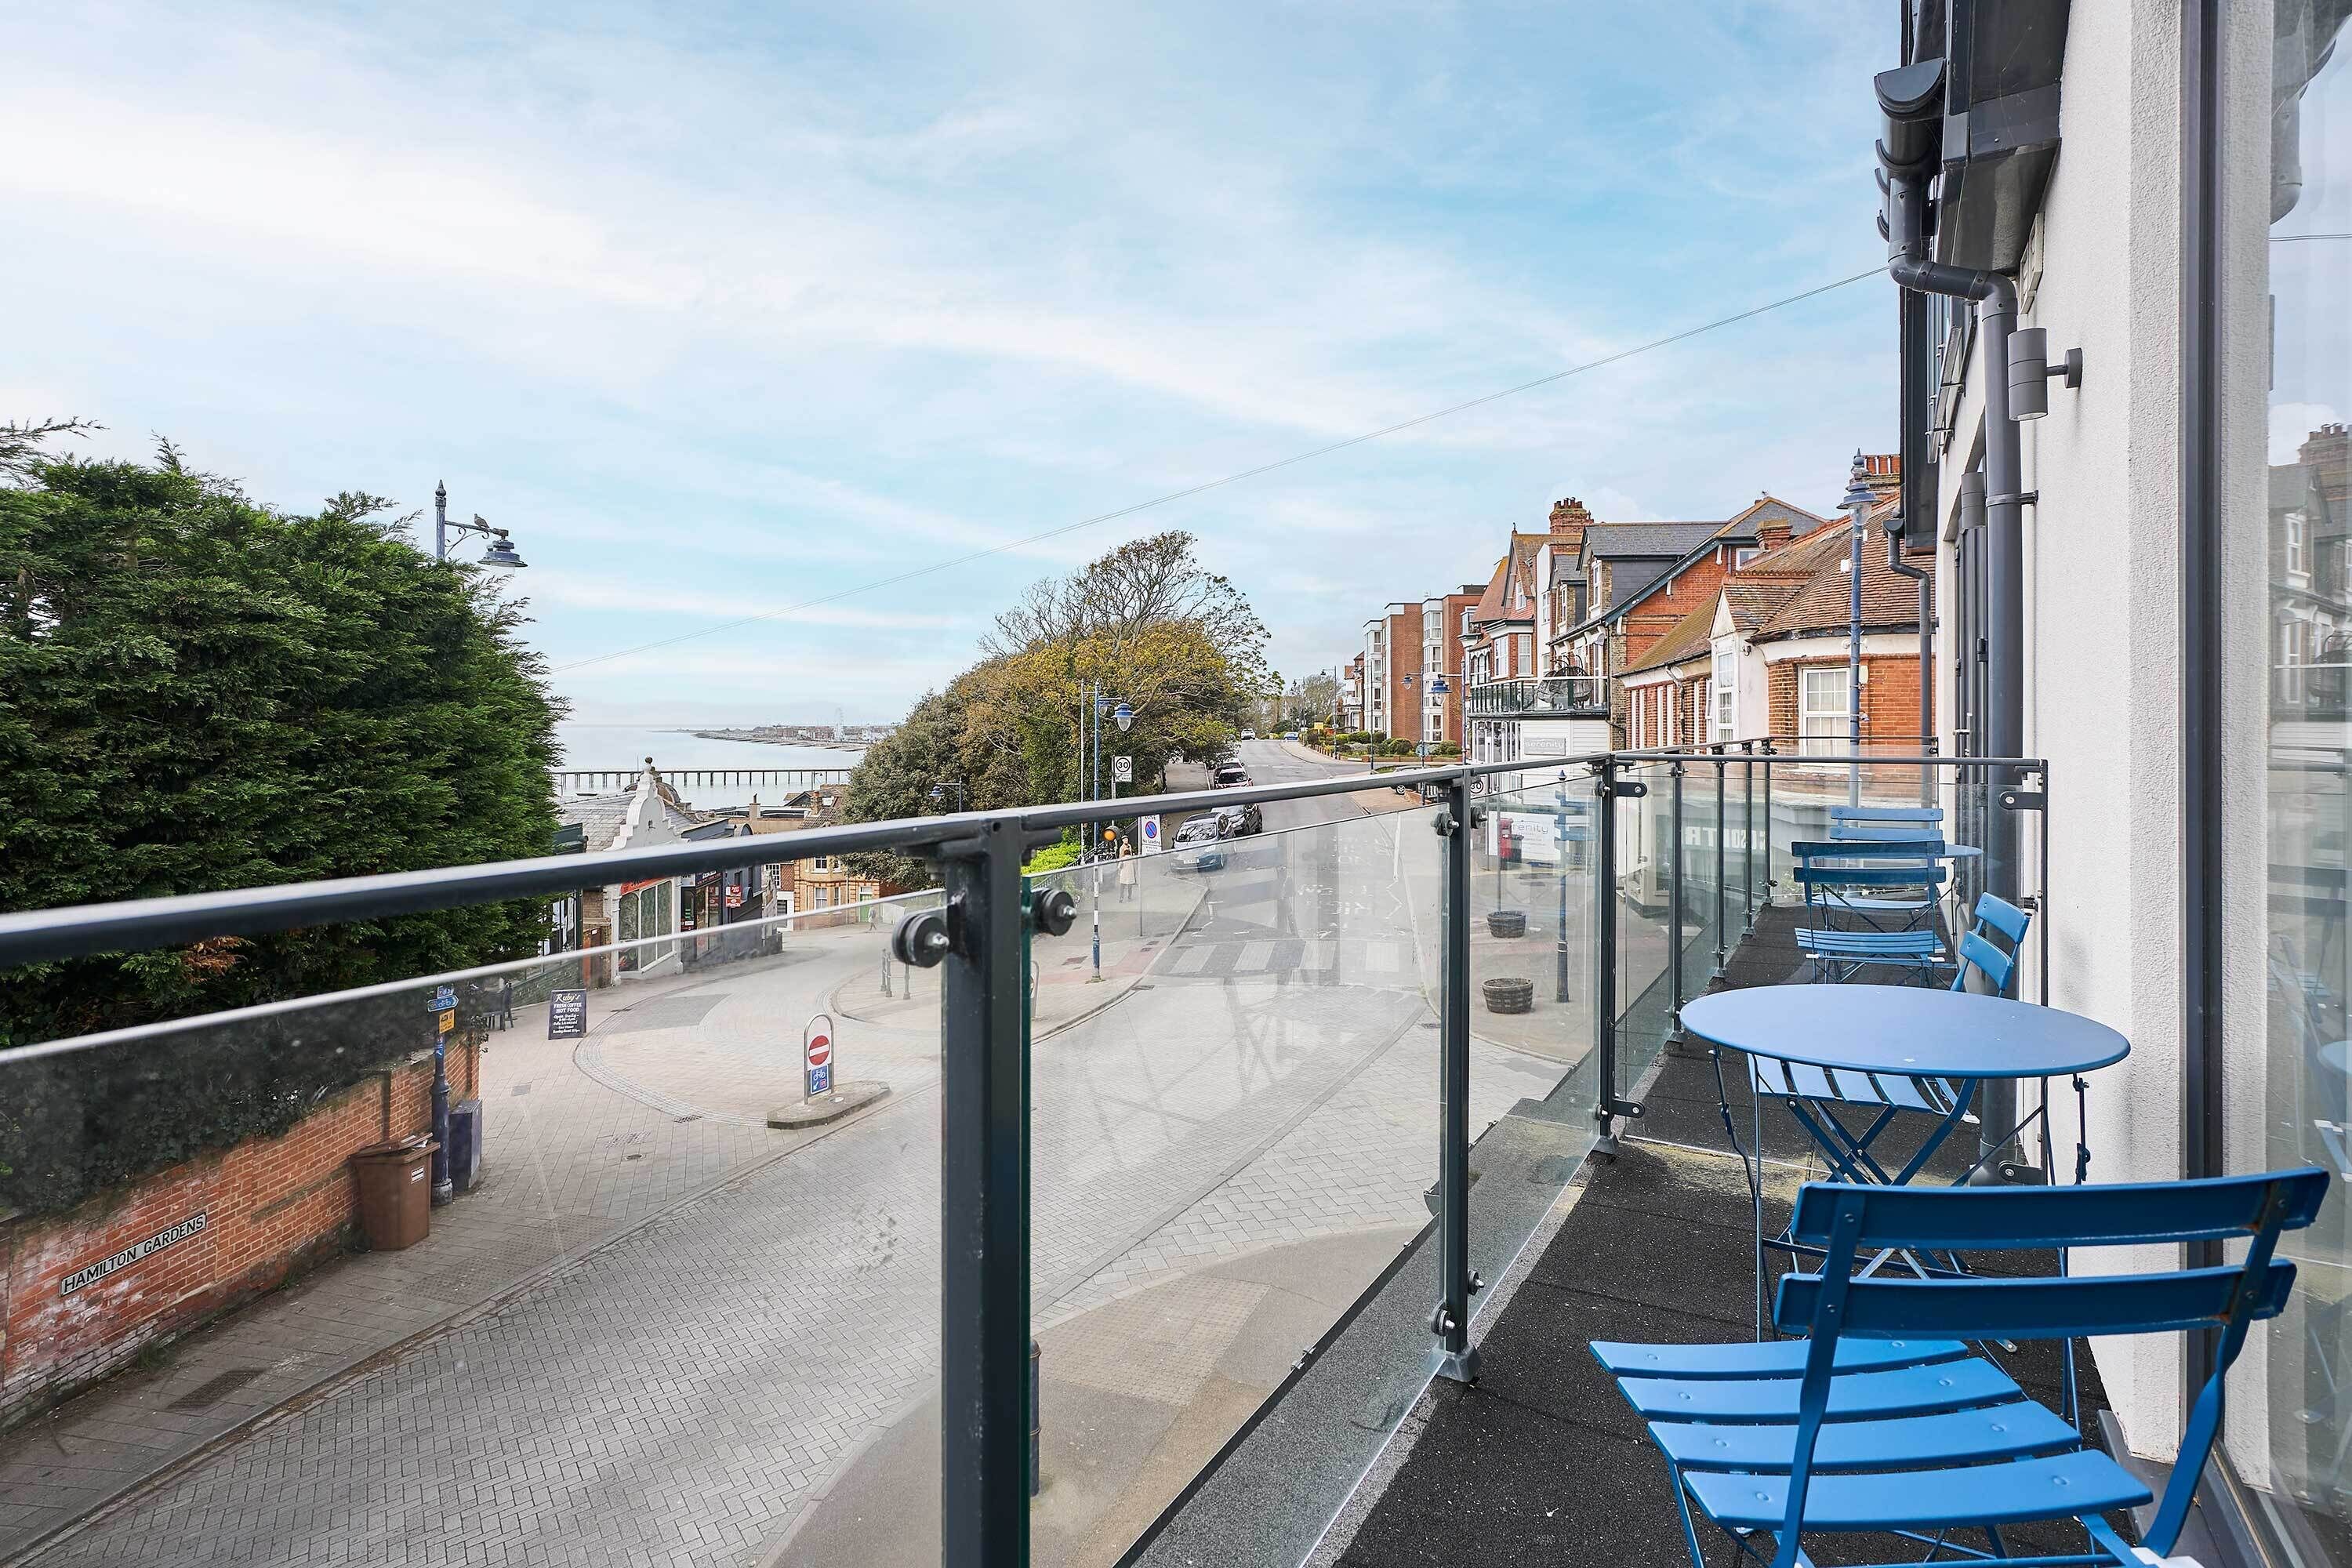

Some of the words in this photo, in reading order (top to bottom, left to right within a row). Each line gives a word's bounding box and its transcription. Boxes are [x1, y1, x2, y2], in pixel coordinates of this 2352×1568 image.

[555, 993, 580, 1003] Ruby's
[64, 1247, 136, 1293] HAMILTON
[143, 1216, 204, 1254] GARDENS
